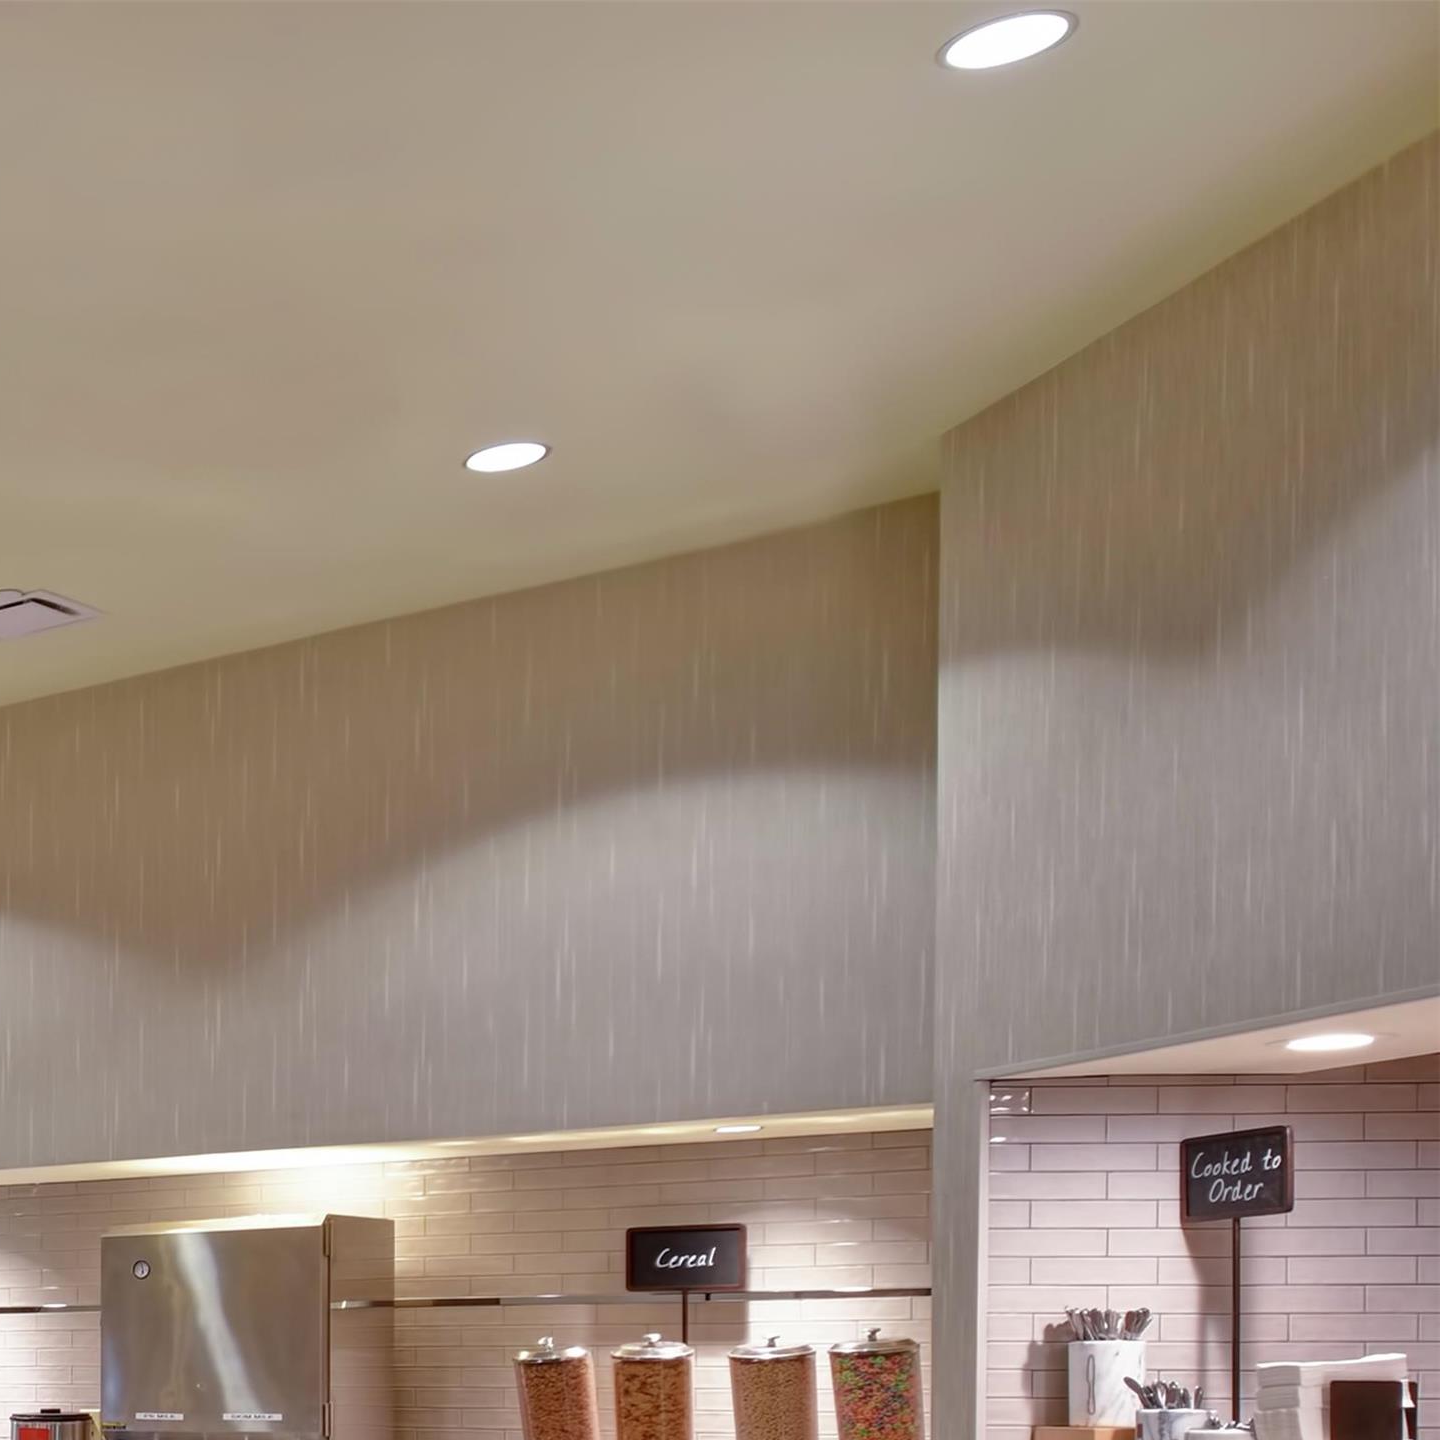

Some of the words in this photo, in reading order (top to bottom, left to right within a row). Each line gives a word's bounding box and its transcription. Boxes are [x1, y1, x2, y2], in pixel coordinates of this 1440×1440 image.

[1191, 1151, 1253, 1178] Cooked
[1262, 1148, 1282, 1171] to
[1209, 1178, 1264, 1202] Order
[655, 1246, 717, 1268] Cereal
